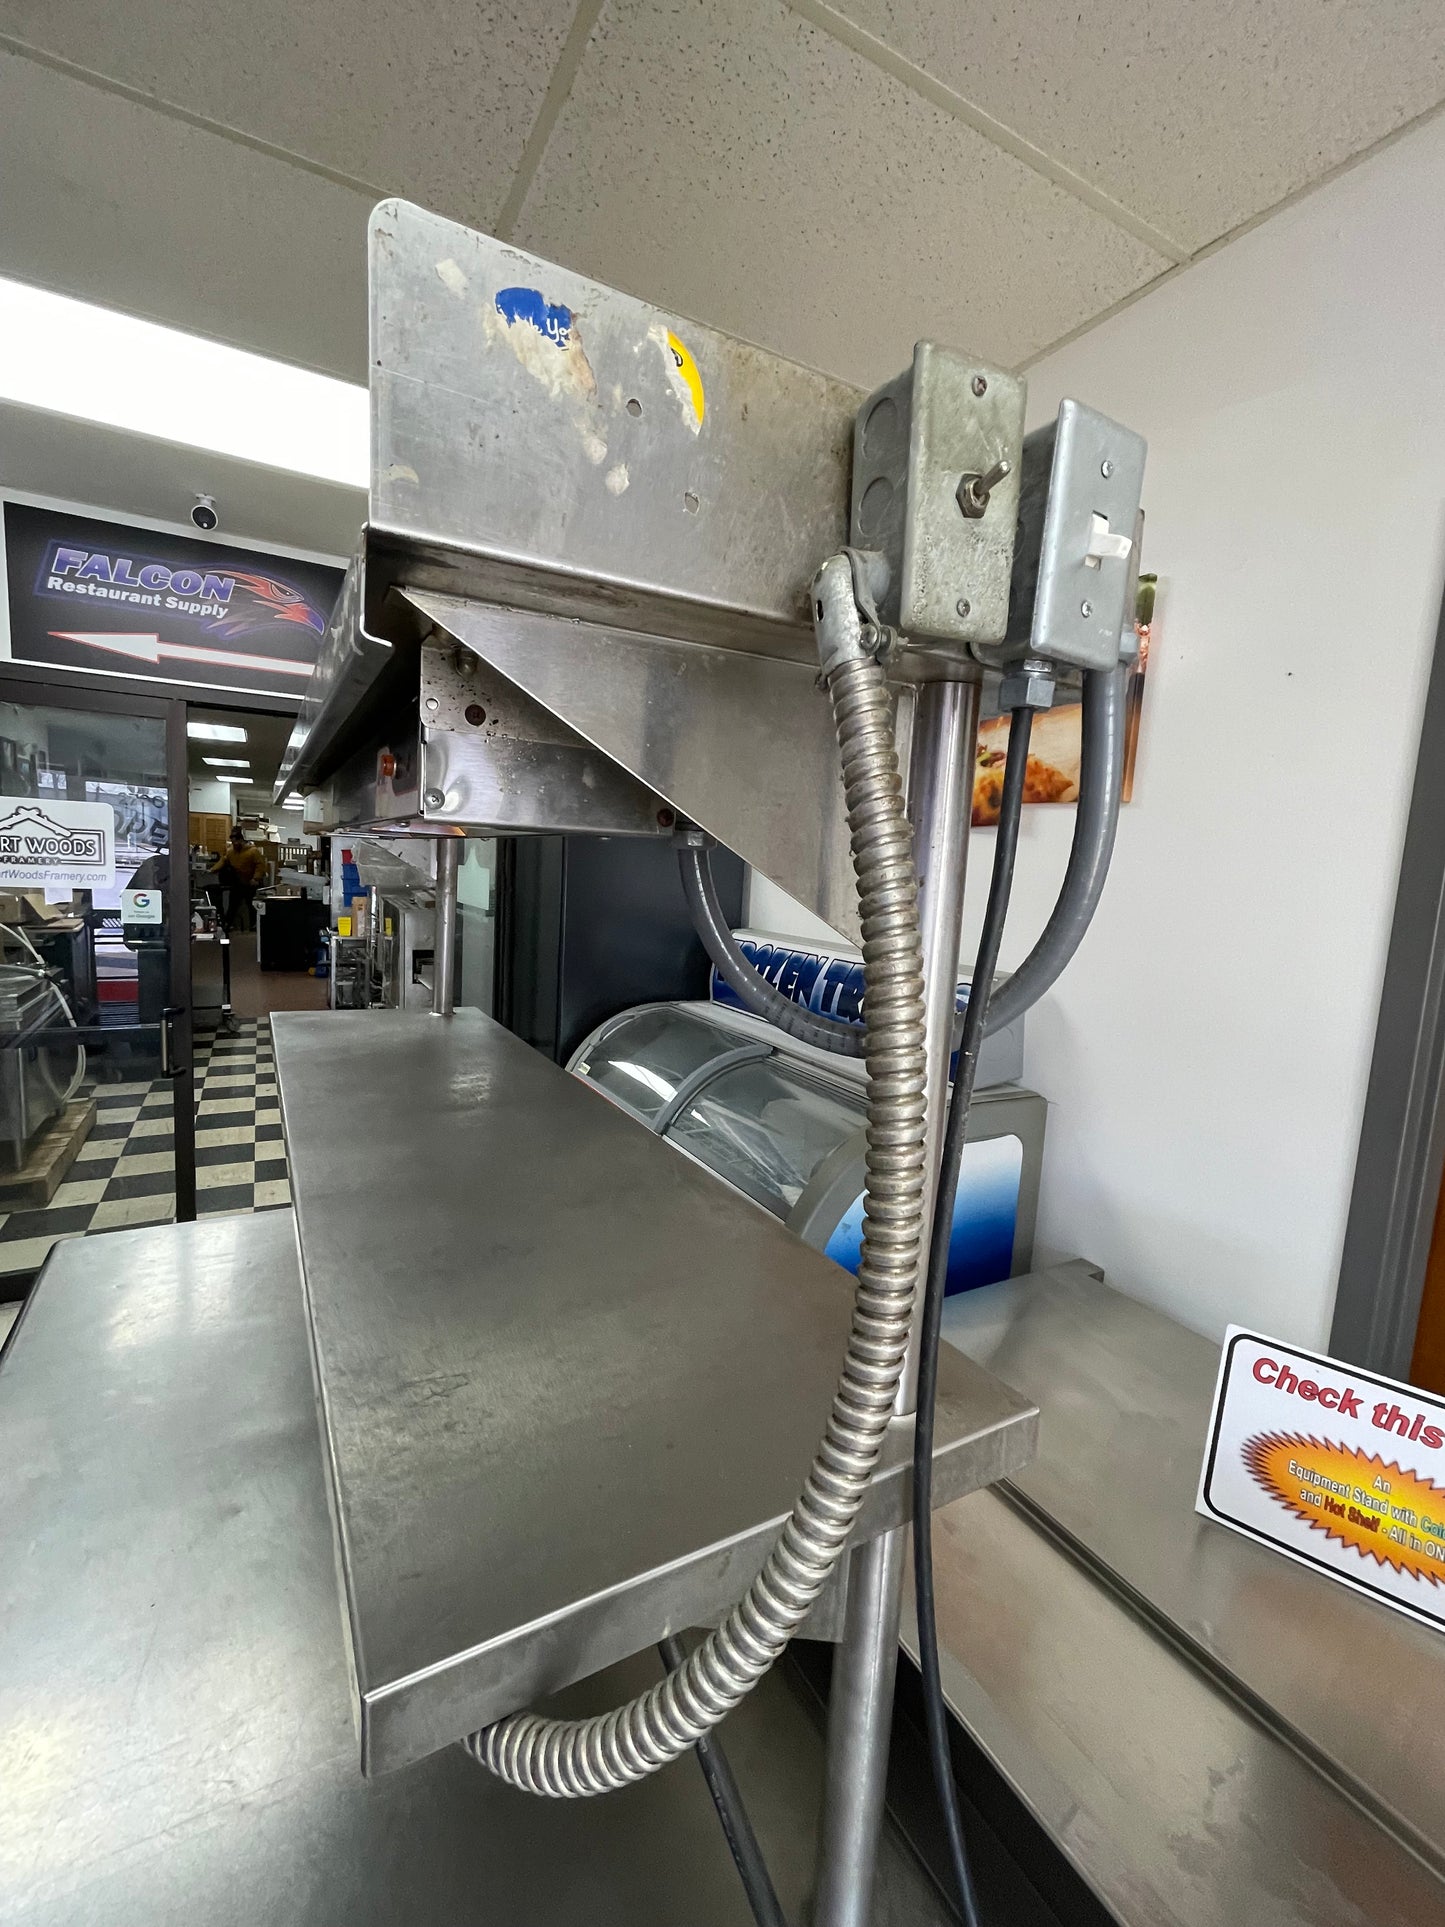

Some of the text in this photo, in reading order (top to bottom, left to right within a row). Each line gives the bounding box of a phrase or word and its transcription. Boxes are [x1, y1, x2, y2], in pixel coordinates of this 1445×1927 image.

[48, 576, 228, 619] Restaurant Supply
[52, 548, 235, 602] FALCON
[3, 856, 58, 864] FRAMERY
[25, 836, 96, 856] WOODS
[714, 939, 829, 1011] OZEN
[1252, 1358, 1445, 1449] Check this
[1288, 1459, 1350, 1498] Equipment
[1353, 1487, 1389, 1515] Stand
[1391, 1504, 1417, 1527] with
[1373, 1475, 1391, 1494] An
[1300, 1489, 1322, 1507] and
[1324, 1494, 1346, 1518] Hot
[1389, 1525, 1406, 1545] All
[1409, 1532, 1422, 1552] in
